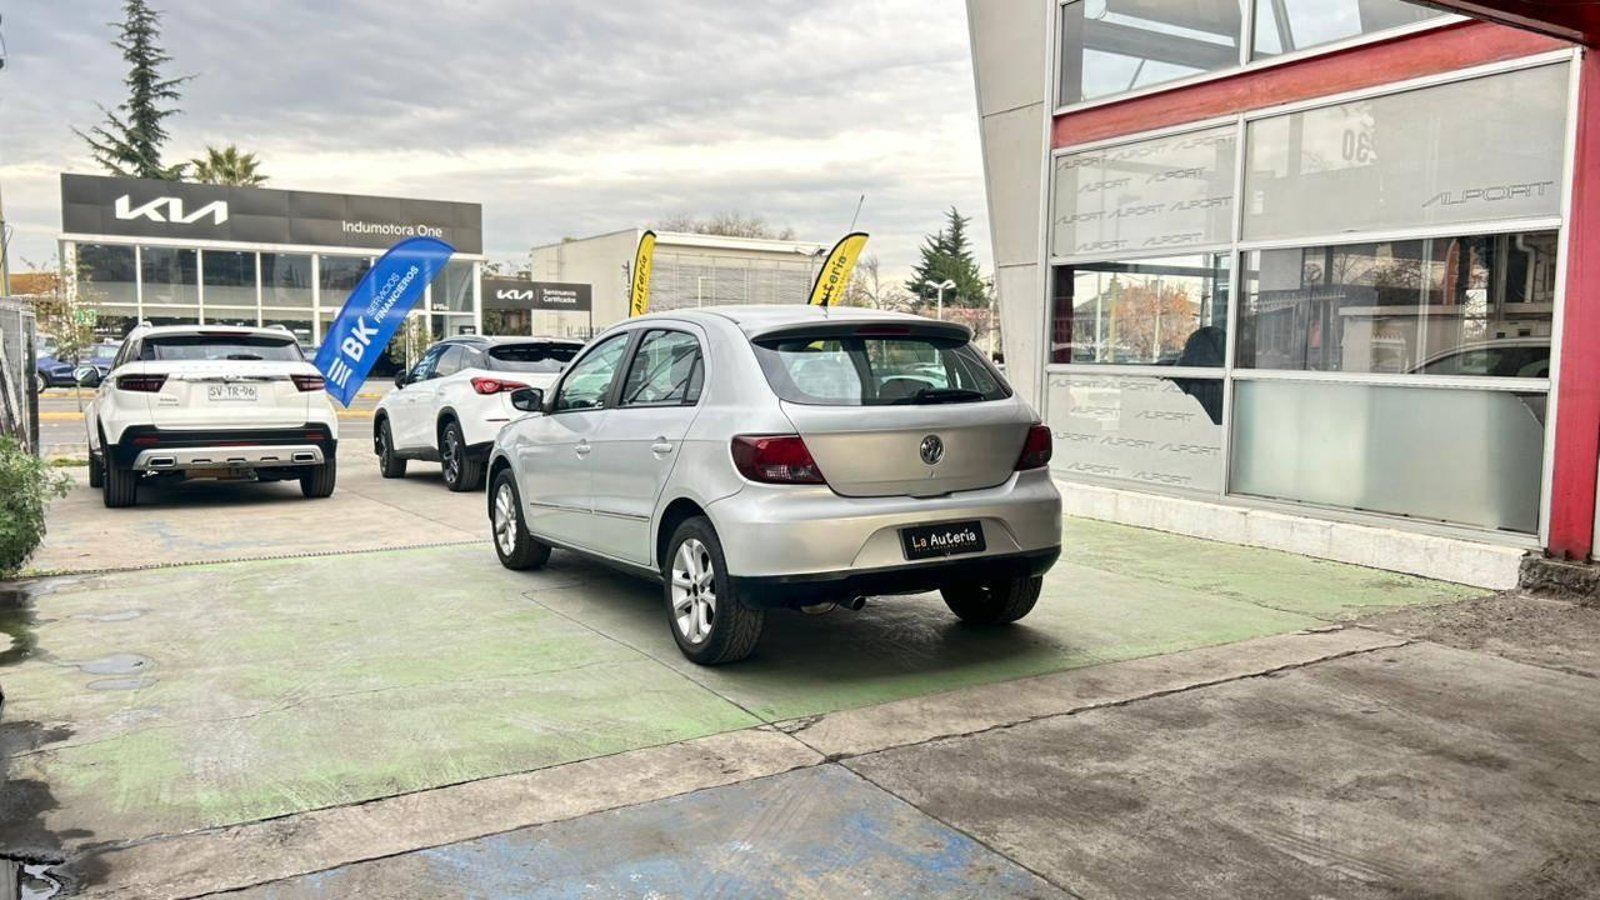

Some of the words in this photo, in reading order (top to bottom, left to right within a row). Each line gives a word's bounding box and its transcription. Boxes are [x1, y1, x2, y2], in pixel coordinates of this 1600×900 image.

[1422, 180, 1554, 208] ALPORT
[115, 194, 228, 225] KIA
[341, 220, 415, 236] Indumotora
[417, 224, 443, 238] One
[366, 272, 400, 317] SERVICIOS
[373, 265, 419, 324] FINANCIEROS
[496, 289, 534, 301] KIA
[340, 315, 379, 363] BK
[911, 535, 927, 549] La
[930, 528, 977, 546] Autería
